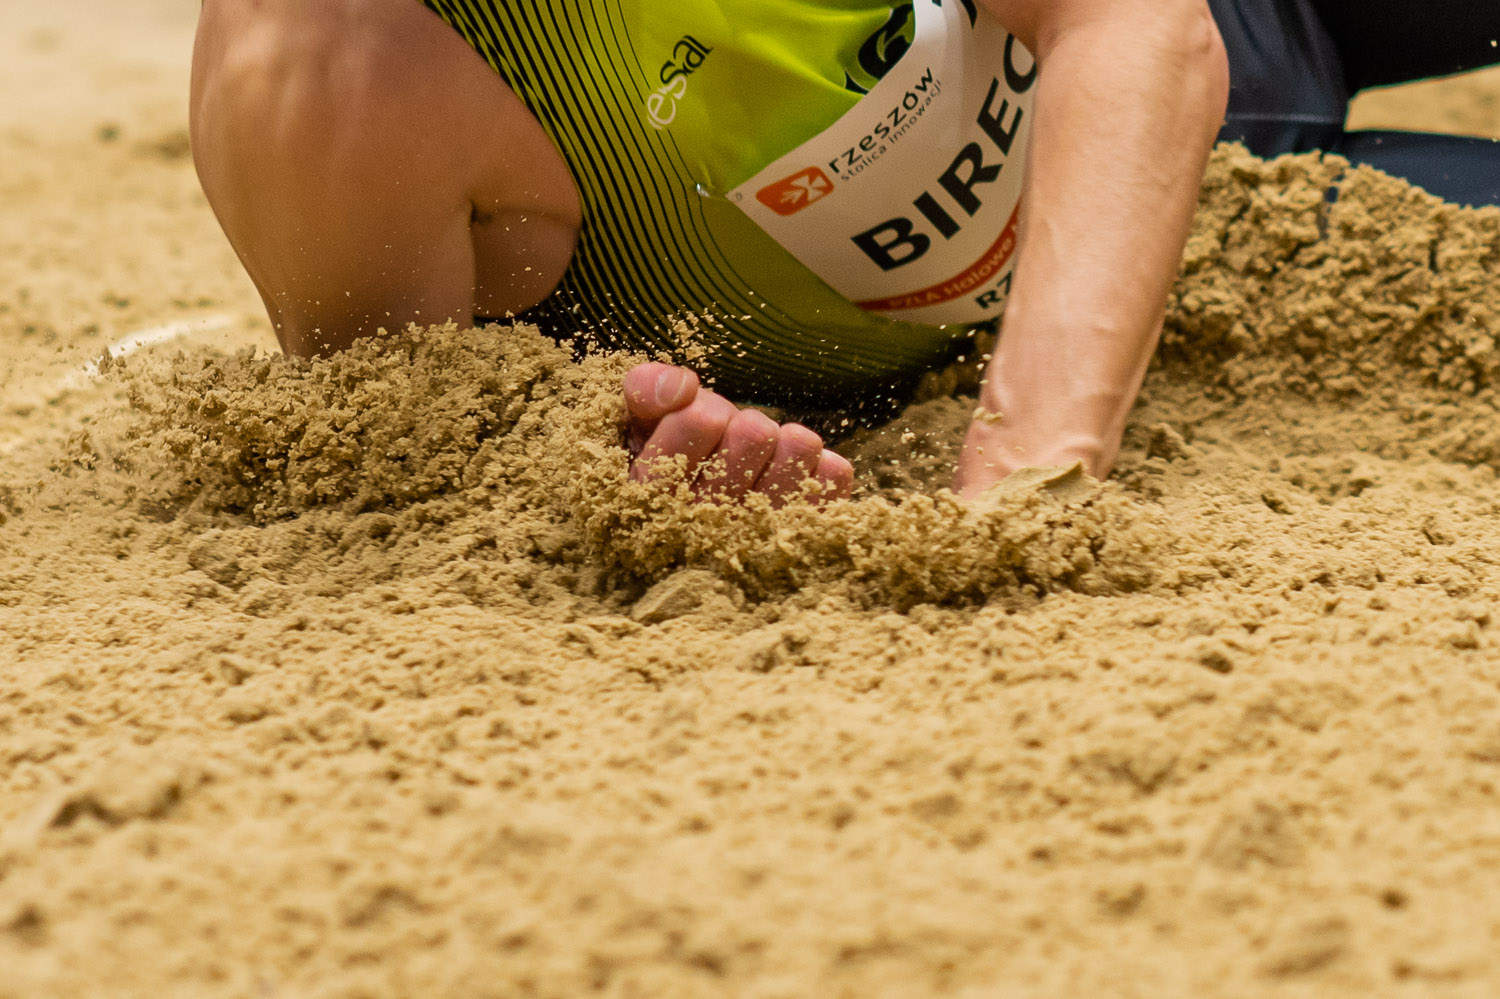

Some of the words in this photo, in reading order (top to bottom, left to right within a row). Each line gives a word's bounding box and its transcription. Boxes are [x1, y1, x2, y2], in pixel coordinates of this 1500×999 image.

[828, 66, 934, 174] rzeszów
[840, 145, 887, 181] stolica
[887, 79, 942, 144] innowacji
